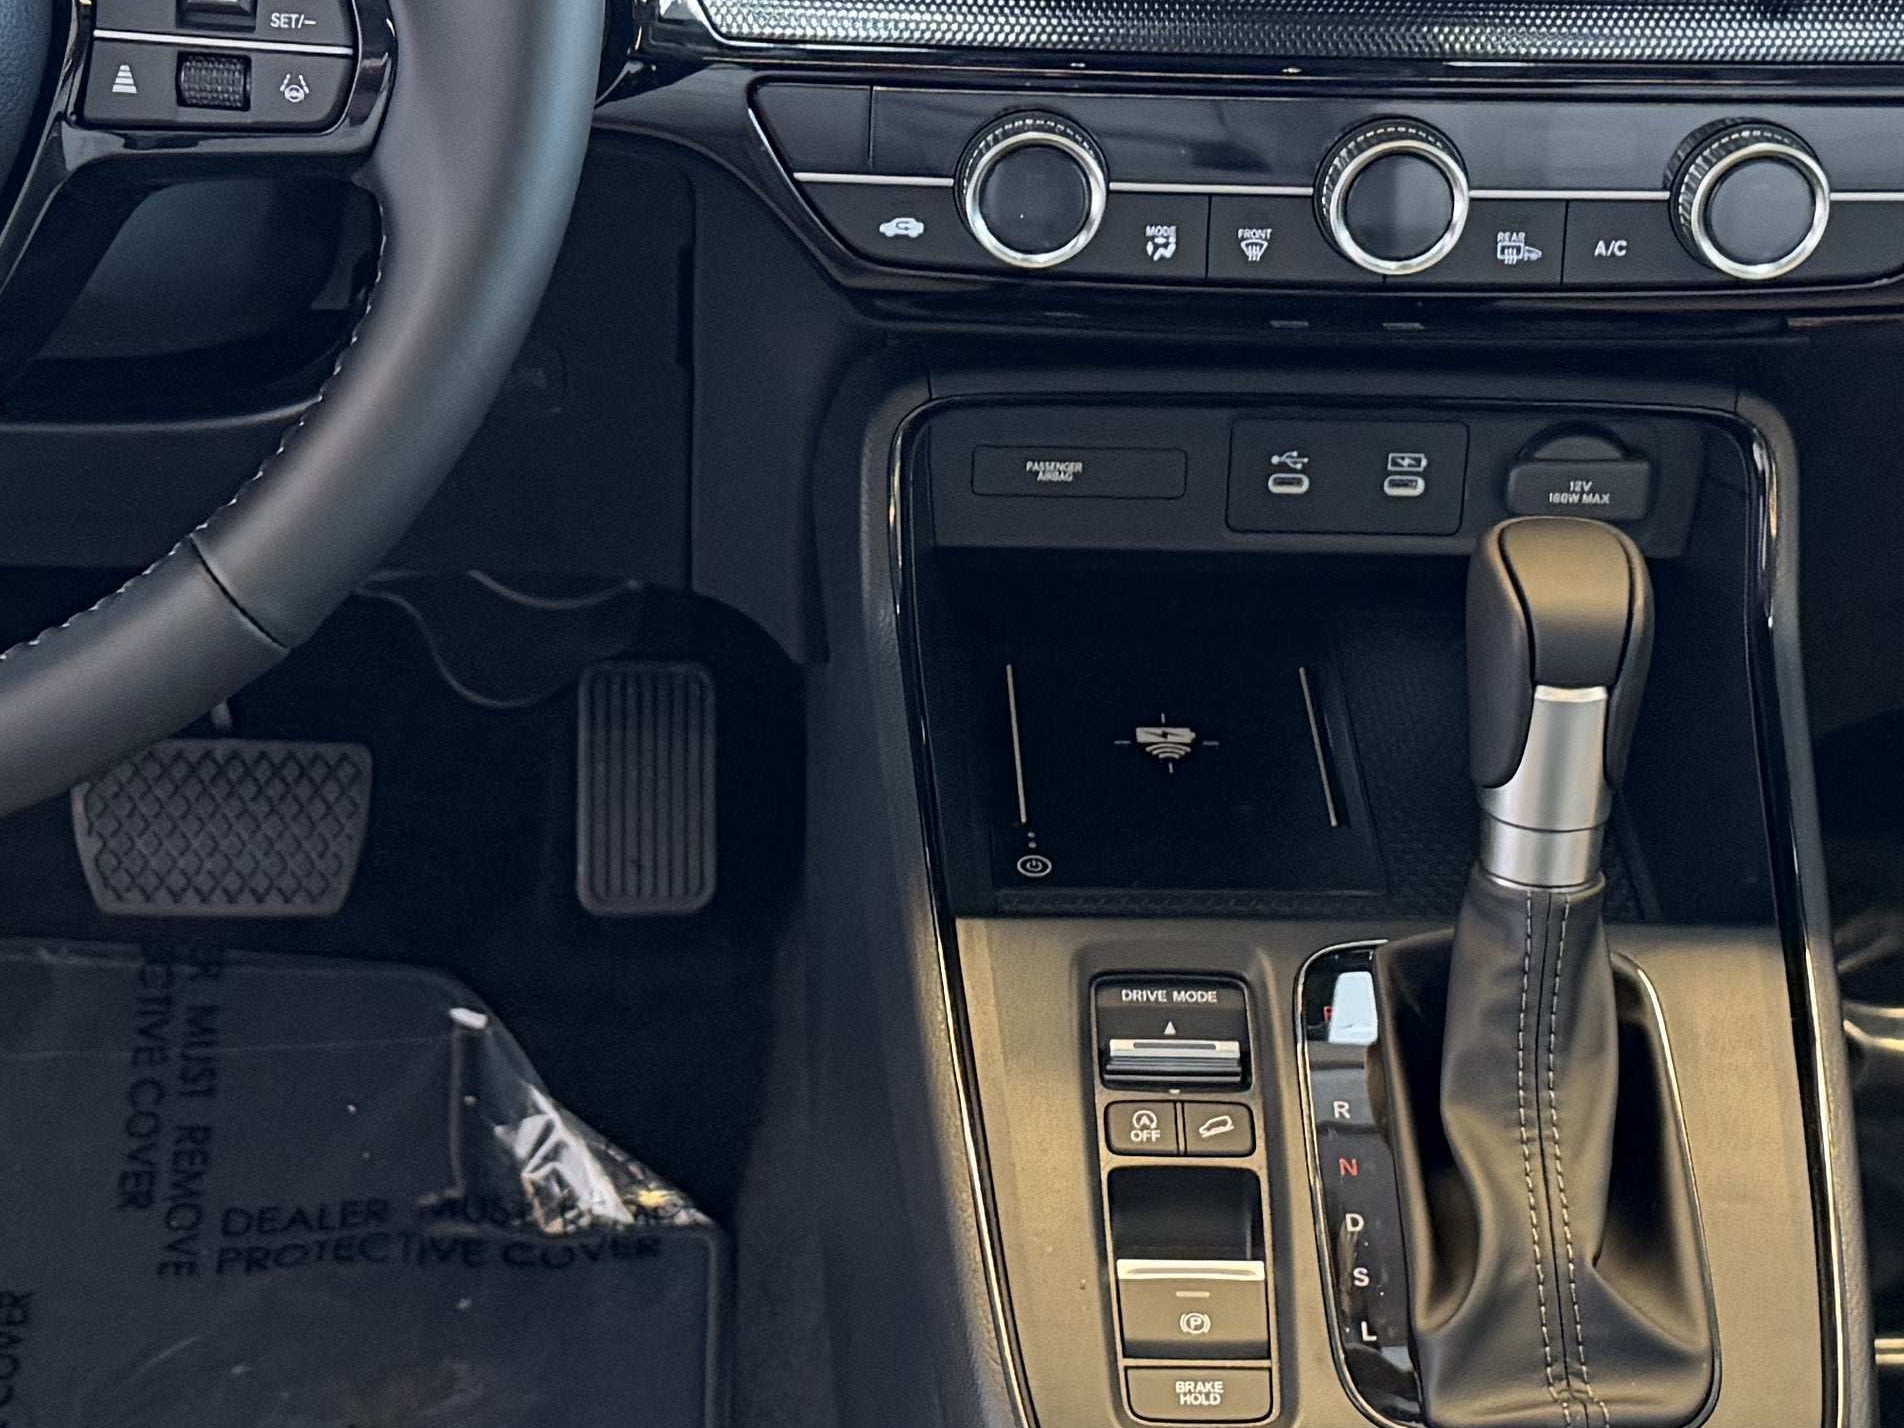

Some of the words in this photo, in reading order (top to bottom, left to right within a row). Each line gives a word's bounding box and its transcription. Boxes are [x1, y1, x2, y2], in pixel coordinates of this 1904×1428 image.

[1145, 225, 1177, 237] MODE
[1237, 228, 1273, 239] FRONT
[1496, 231, 1526, 243] REAR
[1593, 239, 1628, 257] A/C
[1026, 460, 1083, 472] PASSENGER
[1569, 480, 1593, 492] 12V
[1582, 492, 1610, 504] MAX
[1121, 989, 1168, 1002] DRIVE
[1172, 990, 1218, 1003] MODE
[179, 1004, 221, 1099] MUST
[1333, 1101, 1351, 1120] R
[117, 1077, 166, 1212] COVER
[1130, 1129, 1161, 1142] OFF
[1338, 1157, 1358, 1178] N
[157, 1125, 213, 1278] REMOVE
[220, 1198, 392, 1238] DEALER
[1345, 1212, 1365, 1233] D
[215, 1230, 487, 1274] PROTECTIVE
[500, 1232, 662, 1270] COVER
[1353, 1267, 1370, 1288] S
[1361, 1321, 1378, 1343] L
[1175, 1380, 1225, 1393] BRAKE
[1179, 1392, 1222, 1406] HOLD
